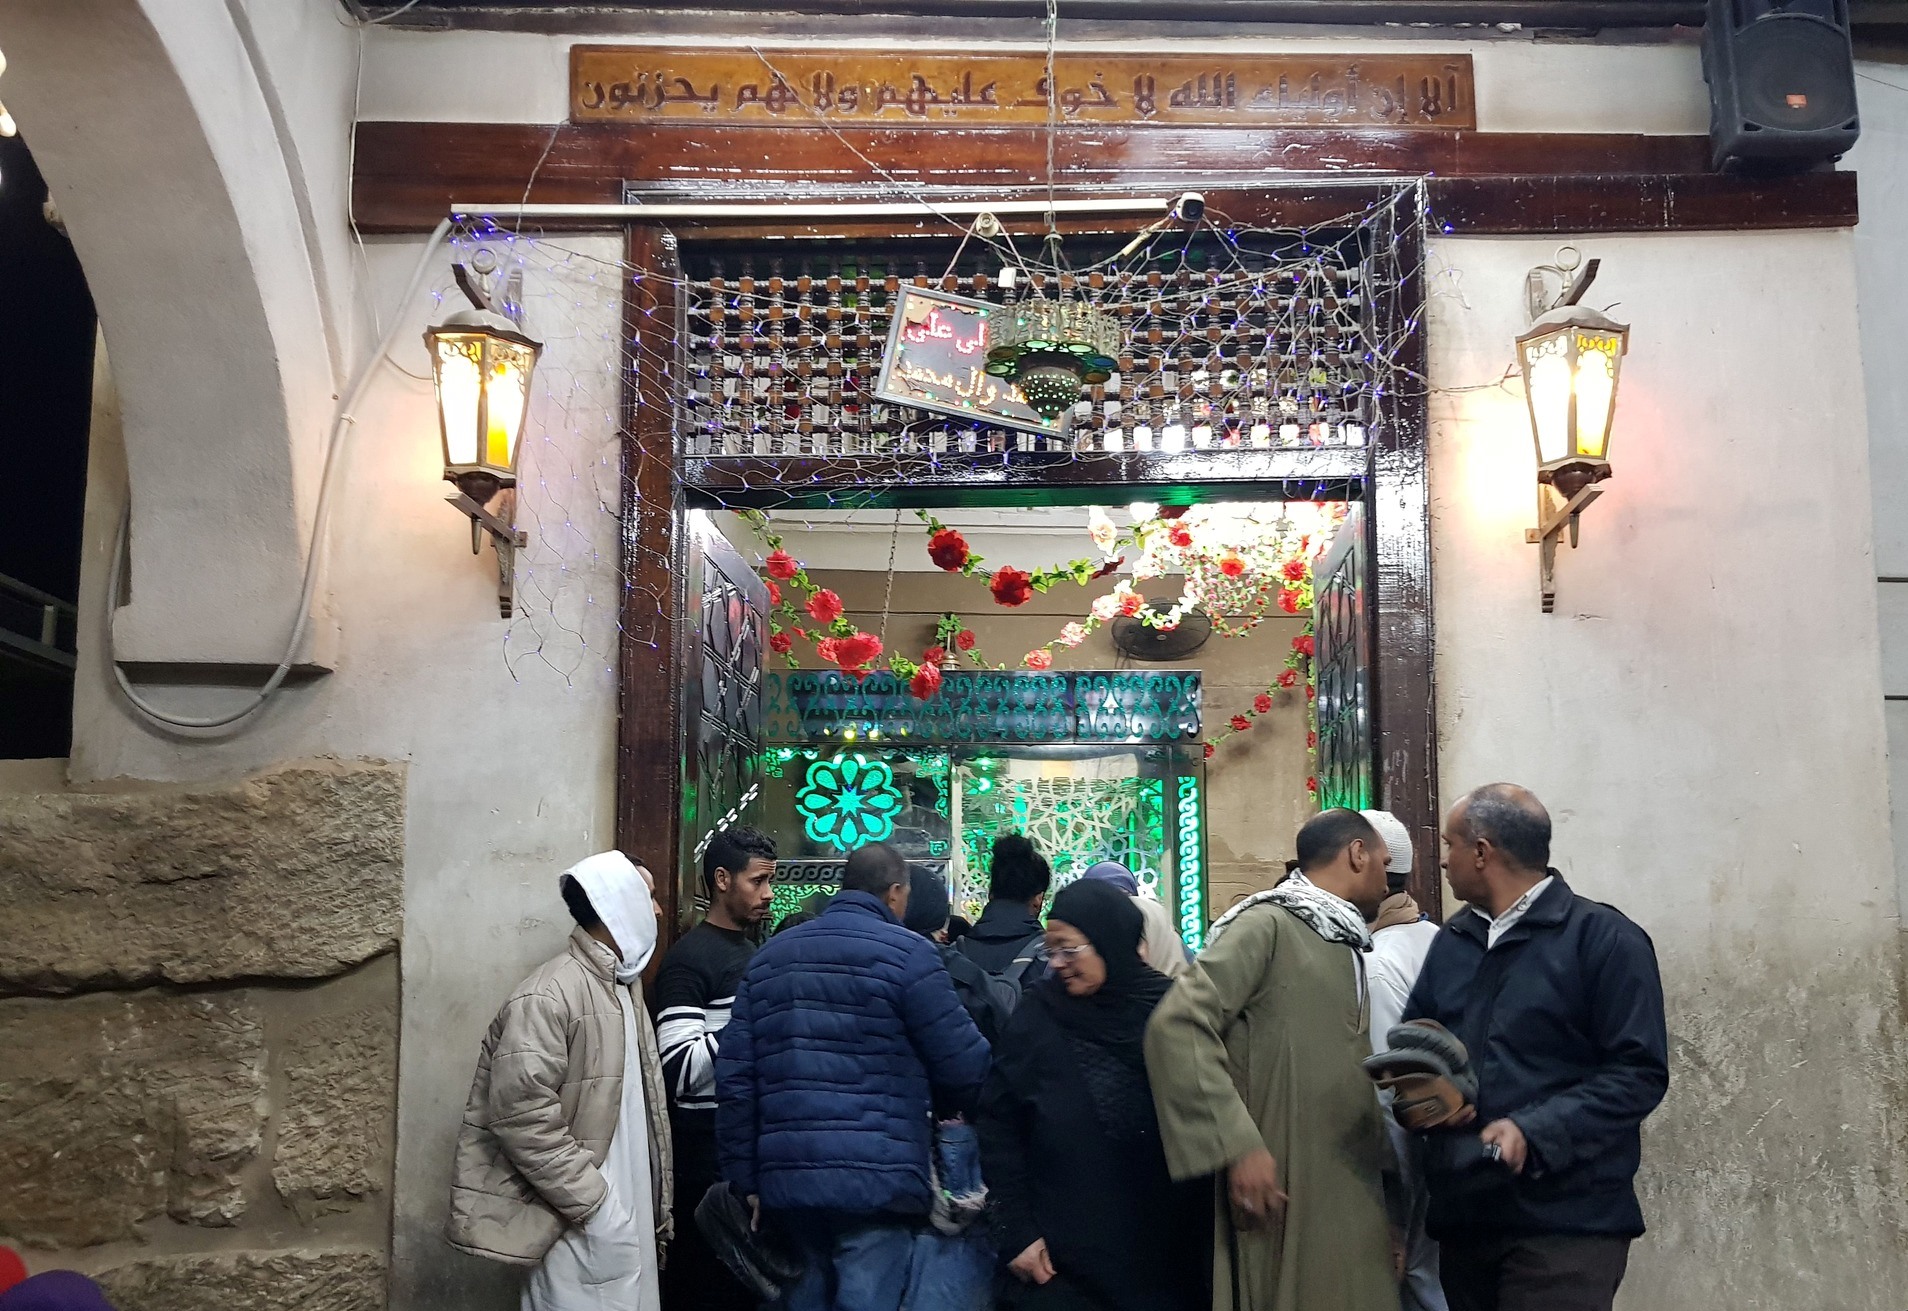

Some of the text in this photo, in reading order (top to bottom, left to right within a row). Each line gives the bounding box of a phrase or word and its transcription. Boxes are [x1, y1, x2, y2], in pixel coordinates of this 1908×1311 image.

[582, 70, 719, 113] يحزنون
[731, 71, 798, 116] هم
[813, 71, 860, 114] ولا
[872, 71, 998, 116] عليهم
[1006, 67, 1120, 117] خوف
[1133, 72, 1157, 119] لا
[1169, 71, 1237, 112] الله
